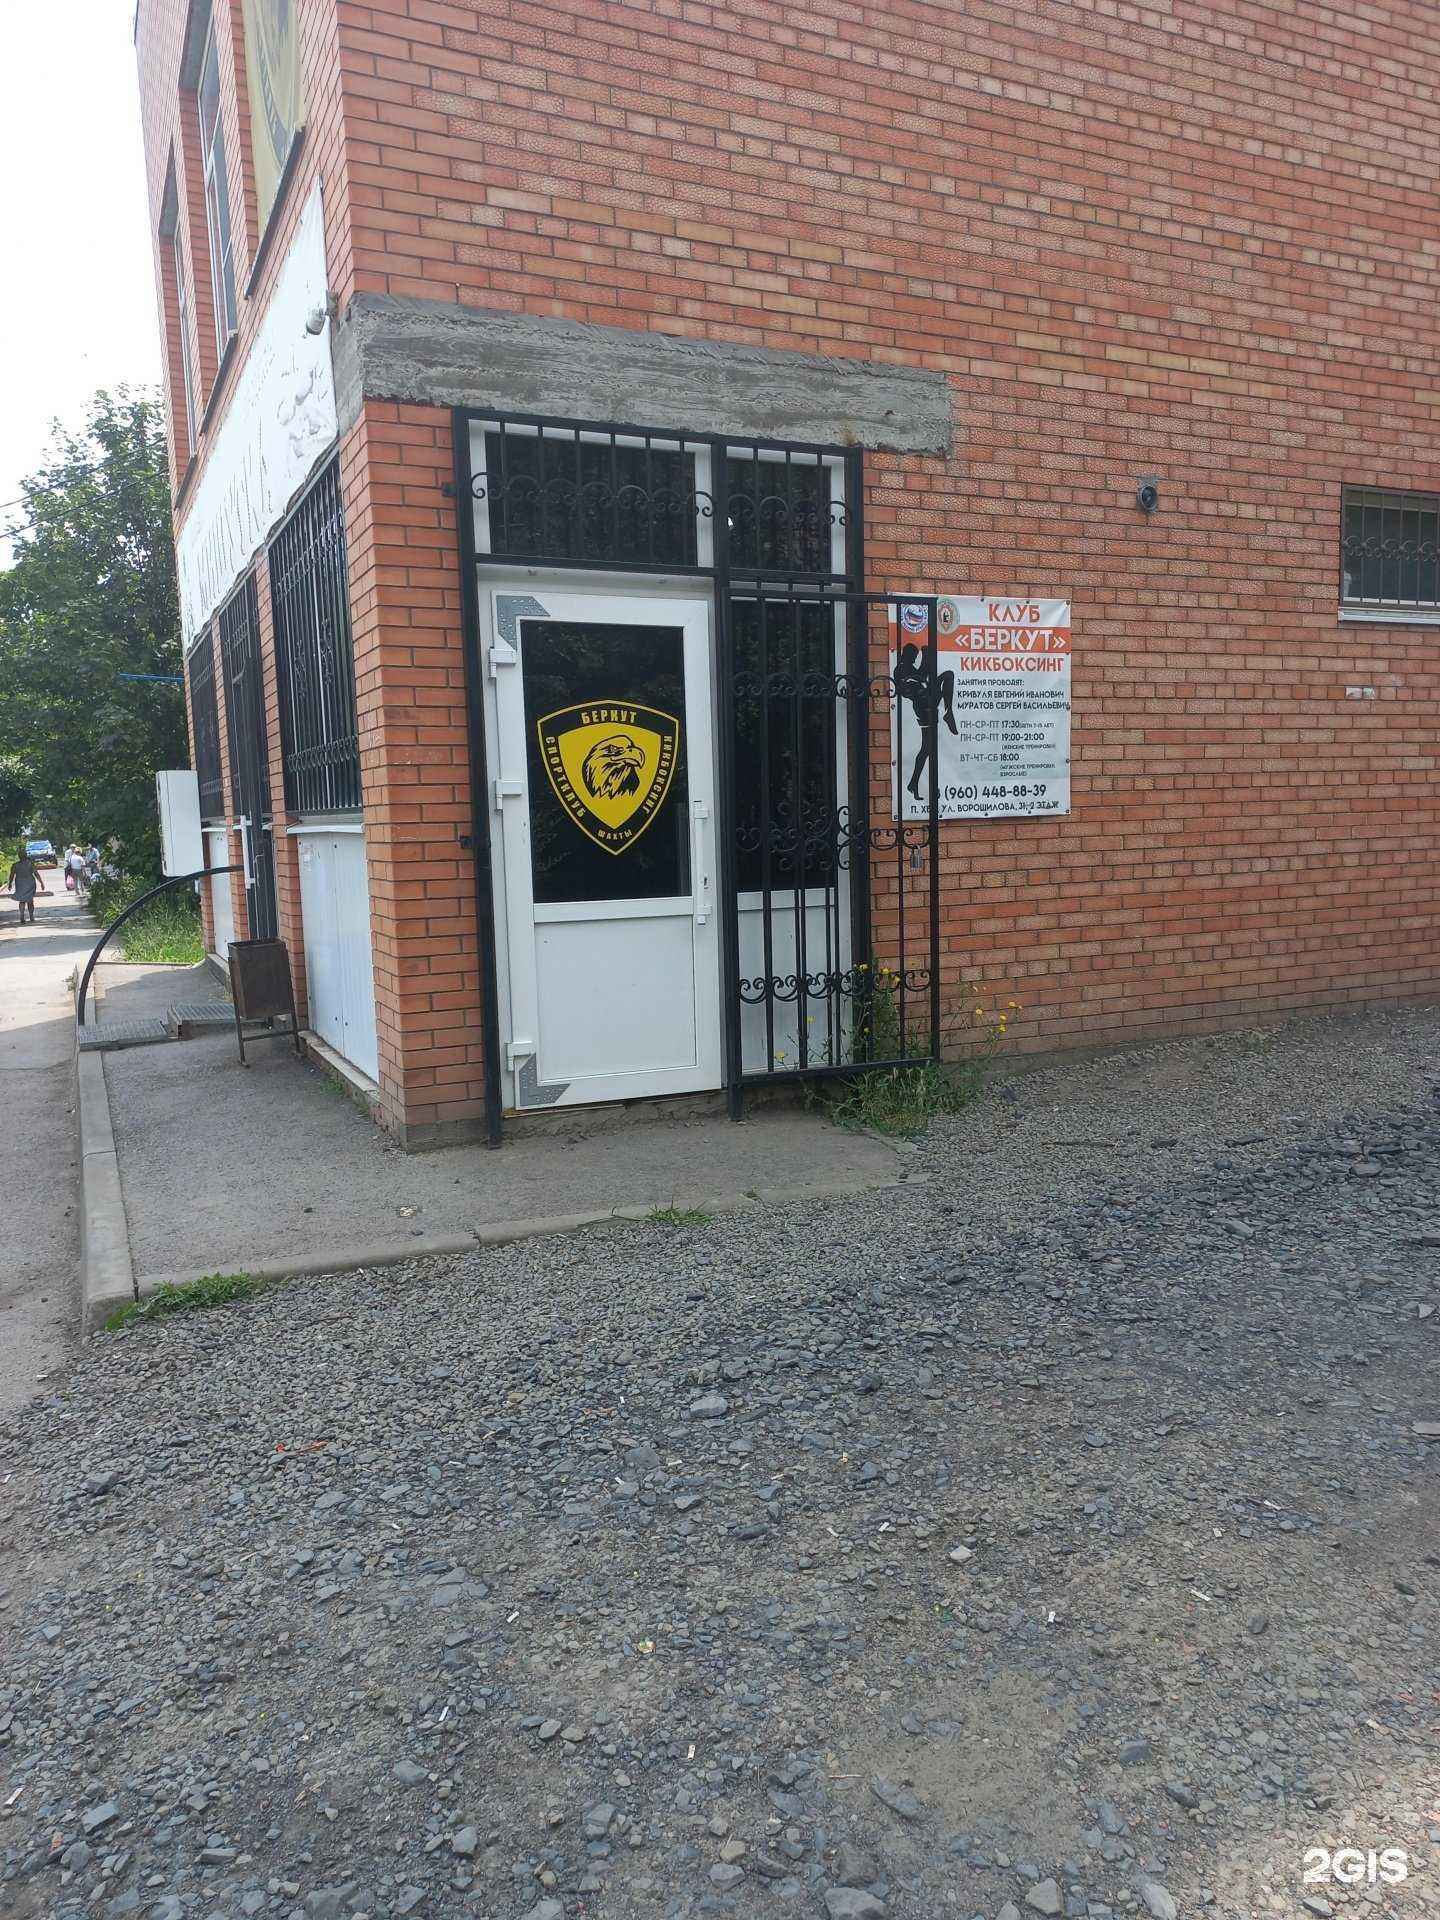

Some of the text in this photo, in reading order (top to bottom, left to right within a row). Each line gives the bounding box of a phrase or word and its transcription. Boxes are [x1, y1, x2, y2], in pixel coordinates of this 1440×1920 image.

[988, 603, 1041, 623] КЛУБ
[954, 627, 1067, 651] «БЕРКУТ»
[959, 656, 1065, 673] КИКБОКСИНГ
[957, 678, 1025, 687] ЗАНЯТИЯ ПРОВОДЯТ:
[957, 689, 1064, 699] КРИВУЛЯ ЕВГЕНИЙ ИВАНОВИЧ
[957, 700, 1069, 710] МУРАТОВ СЕРГЕЙ ВАСИЛЬЕВИЧ
[580, 709, 638, 725] БЕРКУТ
[960, 720, 999, 729] ПН-СР-ПТ
[1001, 720, 1020, 729] 17:30
[960, 732, 1045, 742] ПН-СР-ПТ 19:00-21:00
[960, 752, 1020, 762] ВТ-ЧТ-СБ 18:00
[545, 736, 586, 818] СПОРТКЛУБ
[641, 735, 673, 815] КИКБОКСИНГ
[944, 784, 978, 801] (960)
[982, 784, 1047, 799] 448-88-39
[910, 805, 919, 814] П.
[942, 804, 956, 813] УЛ.
[957, 802, 1018, 812] ВОРОШИЛОВА,
[1036, 800, 1060, 810] ЭТАЖ
[597, 829, 633, 841] ШАХТЫ
